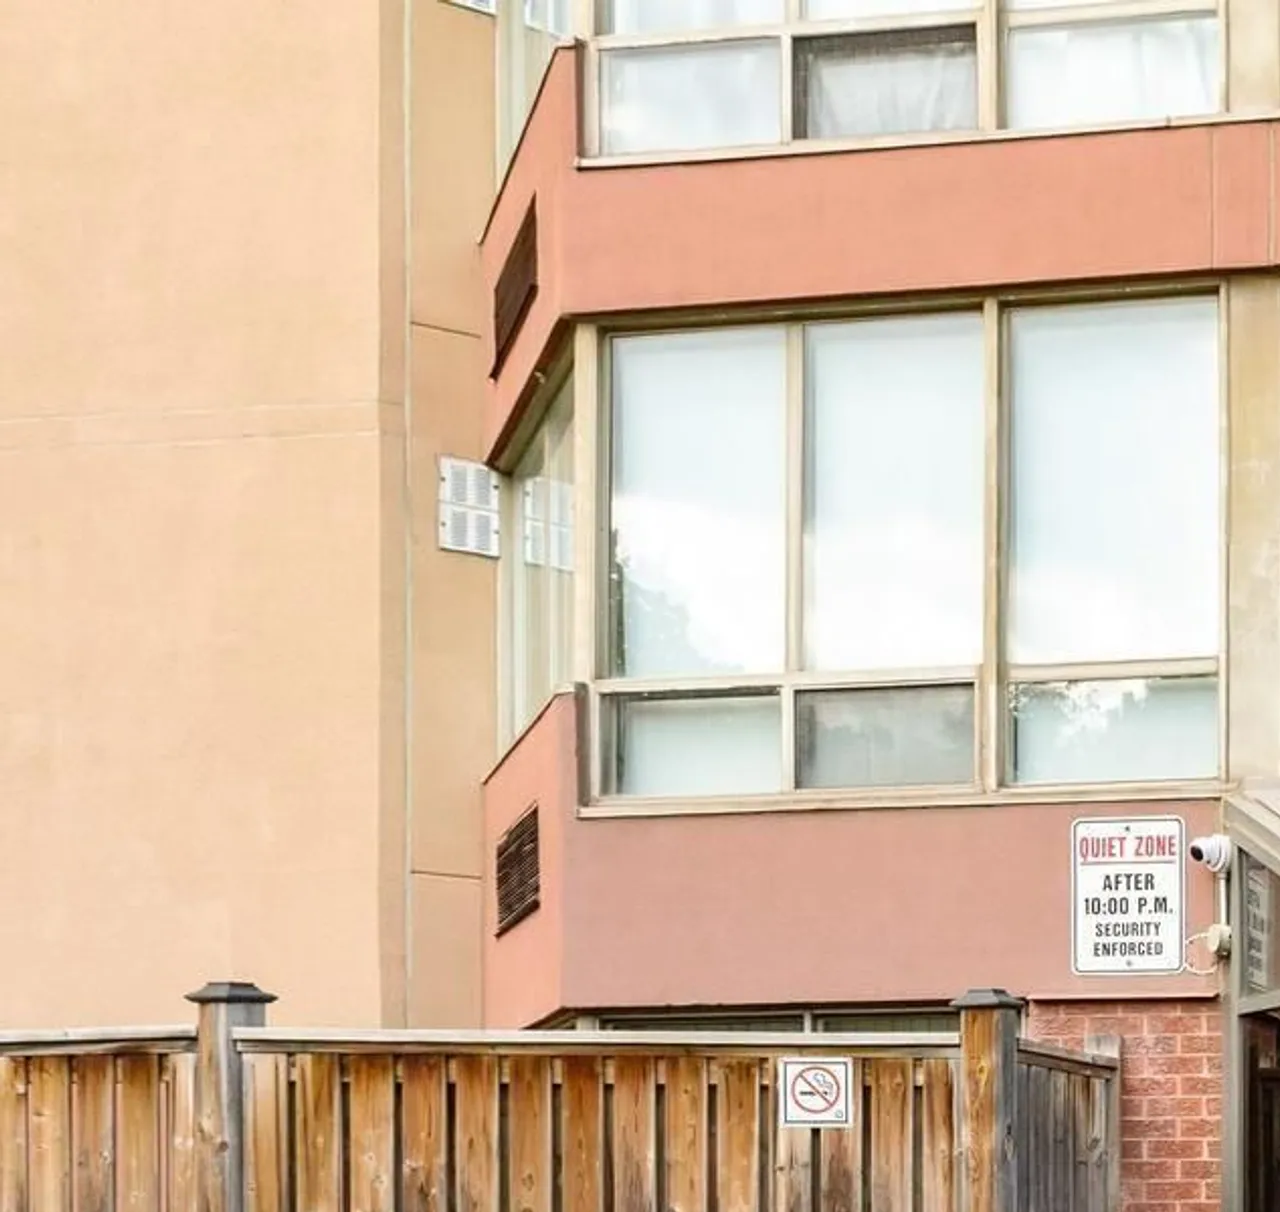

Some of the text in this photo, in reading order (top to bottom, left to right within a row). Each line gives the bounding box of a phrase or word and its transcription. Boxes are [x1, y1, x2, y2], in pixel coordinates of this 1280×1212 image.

[1080, 835, 1176, 861] QUIET ZONE
[1102, 873, 1155, 890] AFTER
[1084, 896, 1173, 915] 10:00 P.M.
[1095, 922, 1161, 937] SECURITY
[1093, 942, 1163, 957] ENFORCED
